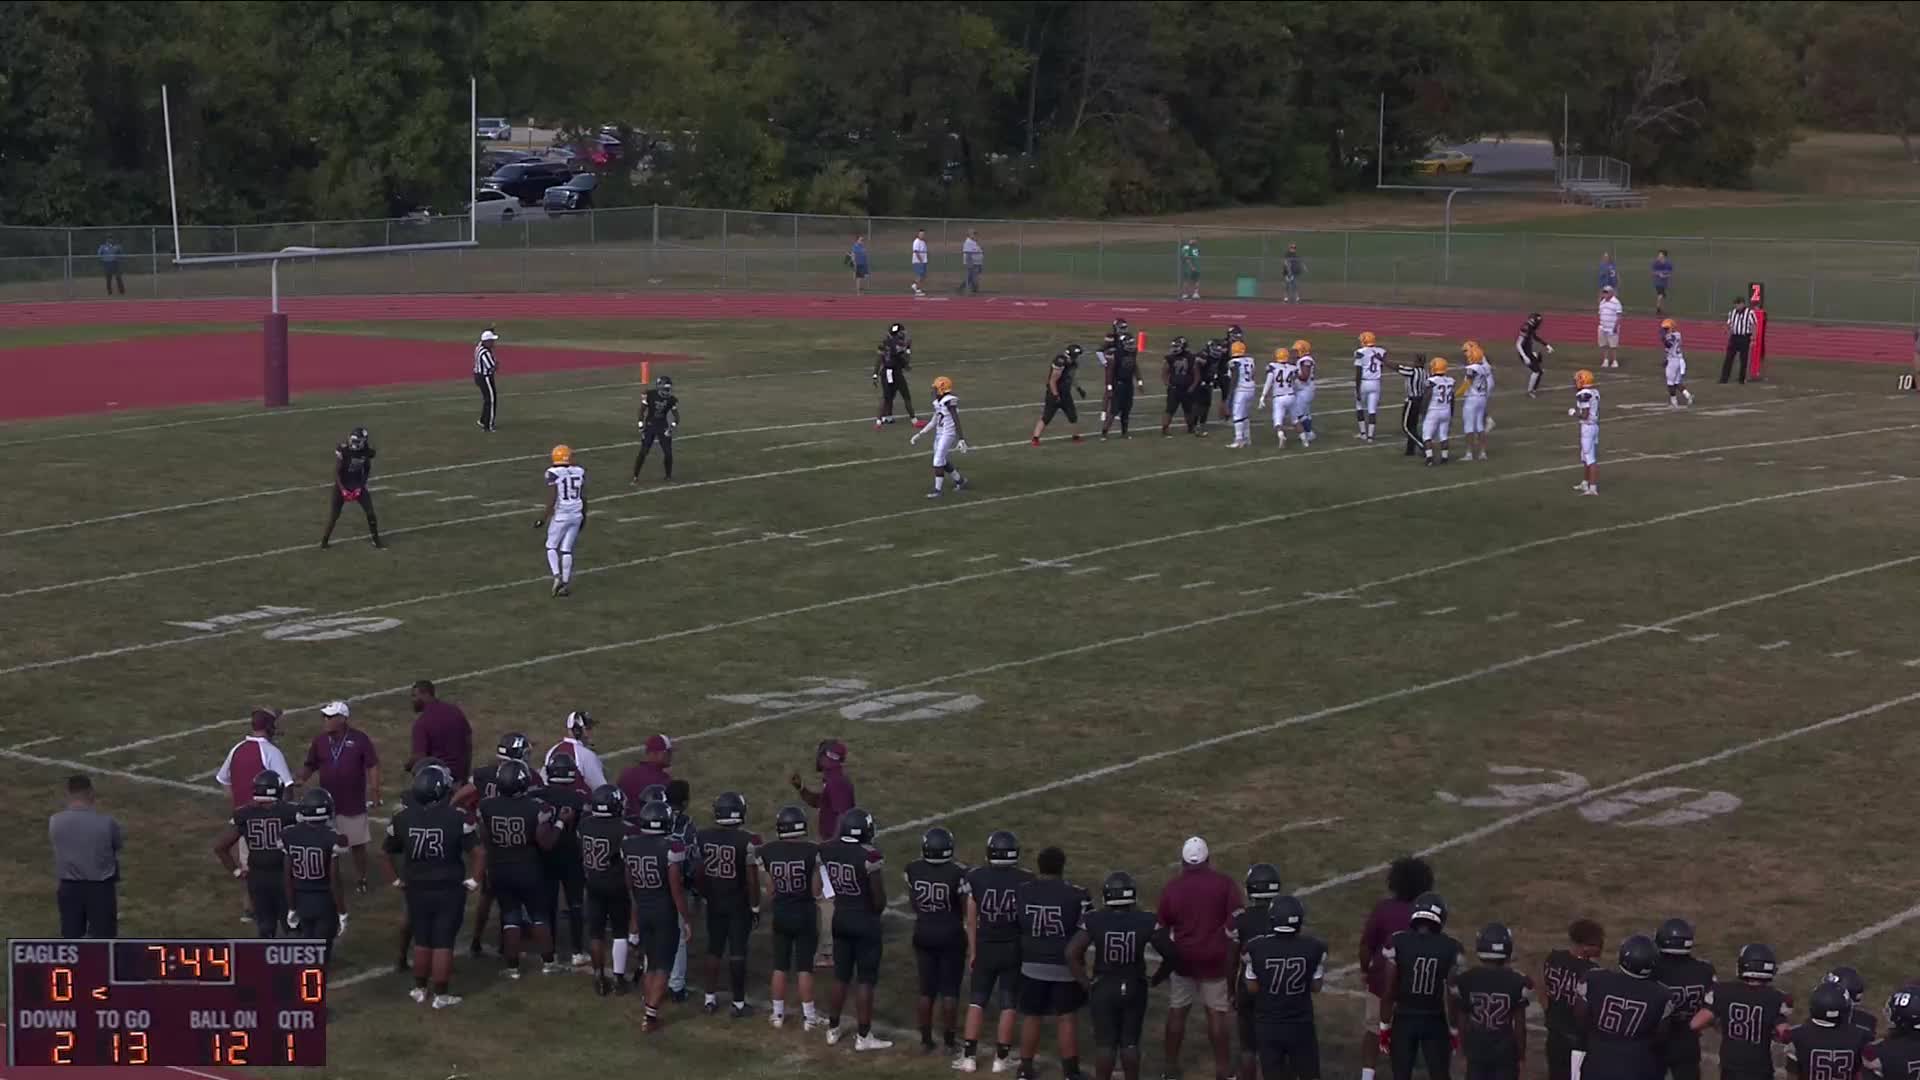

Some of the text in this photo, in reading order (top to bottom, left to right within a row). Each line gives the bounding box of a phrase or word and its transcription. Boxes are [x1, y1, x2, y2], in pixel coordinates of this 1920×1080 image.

[1898, 373, 1913, 391] 10
[561, 476, 582, 500] 15
[247, 817, 282, 851] 50
[408, 828, 445, 860] 73
[491, 816, 527, 849] 58
[288, 846, 325, 881] 30
[582, 835, 610, 870] 82
[704, 843, 737, 879] 28
[626, 855, 664, 889] 36
[769, 860, 807, 894] 86
[914, 880, 952, 912] 29
[980, 888, 1017, 922] 44
[1024, 904, 1066, 938] 75
[1103, 930, 1137, 965] 61
[1264, 956, 1308, 996] 72
[1411, 956, 1440, 996] 11
[1598, 993, 1648, 1038] 67
[1893, 992, 1912, 1007] 78
[1728, 1001, 1764, 1045] 81
[1809, 1048, 1856, 1080] 63
